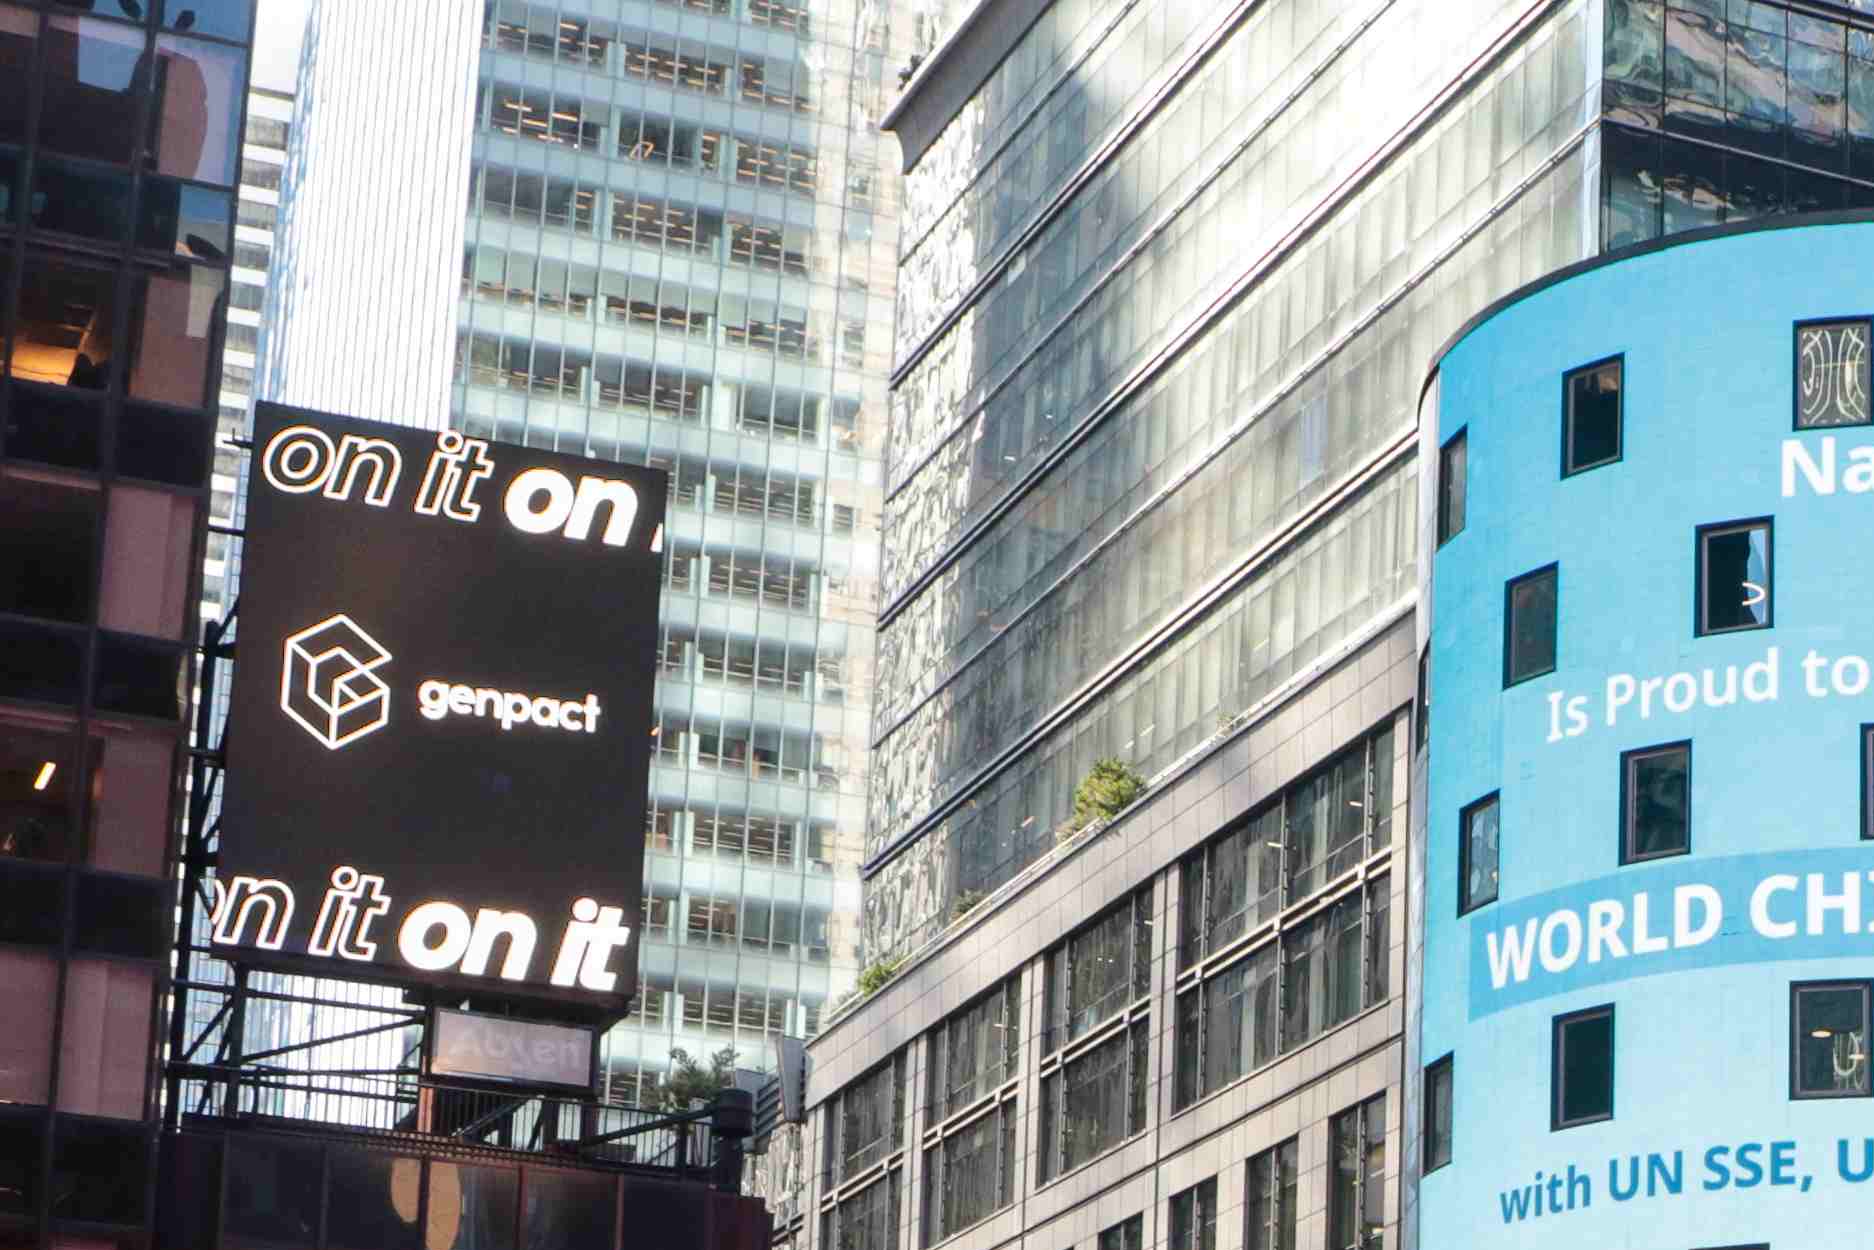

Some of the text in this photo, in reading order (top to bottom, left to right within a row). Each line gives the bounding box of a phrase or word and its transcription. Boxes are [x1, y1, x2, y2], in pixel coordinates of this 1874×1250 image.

[264, 427, 638, 546] on it on
[418, 679, 600, 733] genpact
[1545, 688, 1588, 742] Is
[1605, 647, 1779, 727] Proud
[1803, 646, 1871, 698] to
[209, 866, 630, 991] n it on it
[1486, 882, 1724, 989] WORLD
[1499, 1162, 1592, 1225] with
[1607, 1148, 1685, 1202] UN
[1704, 1138, 1814, 1193] SSE,
